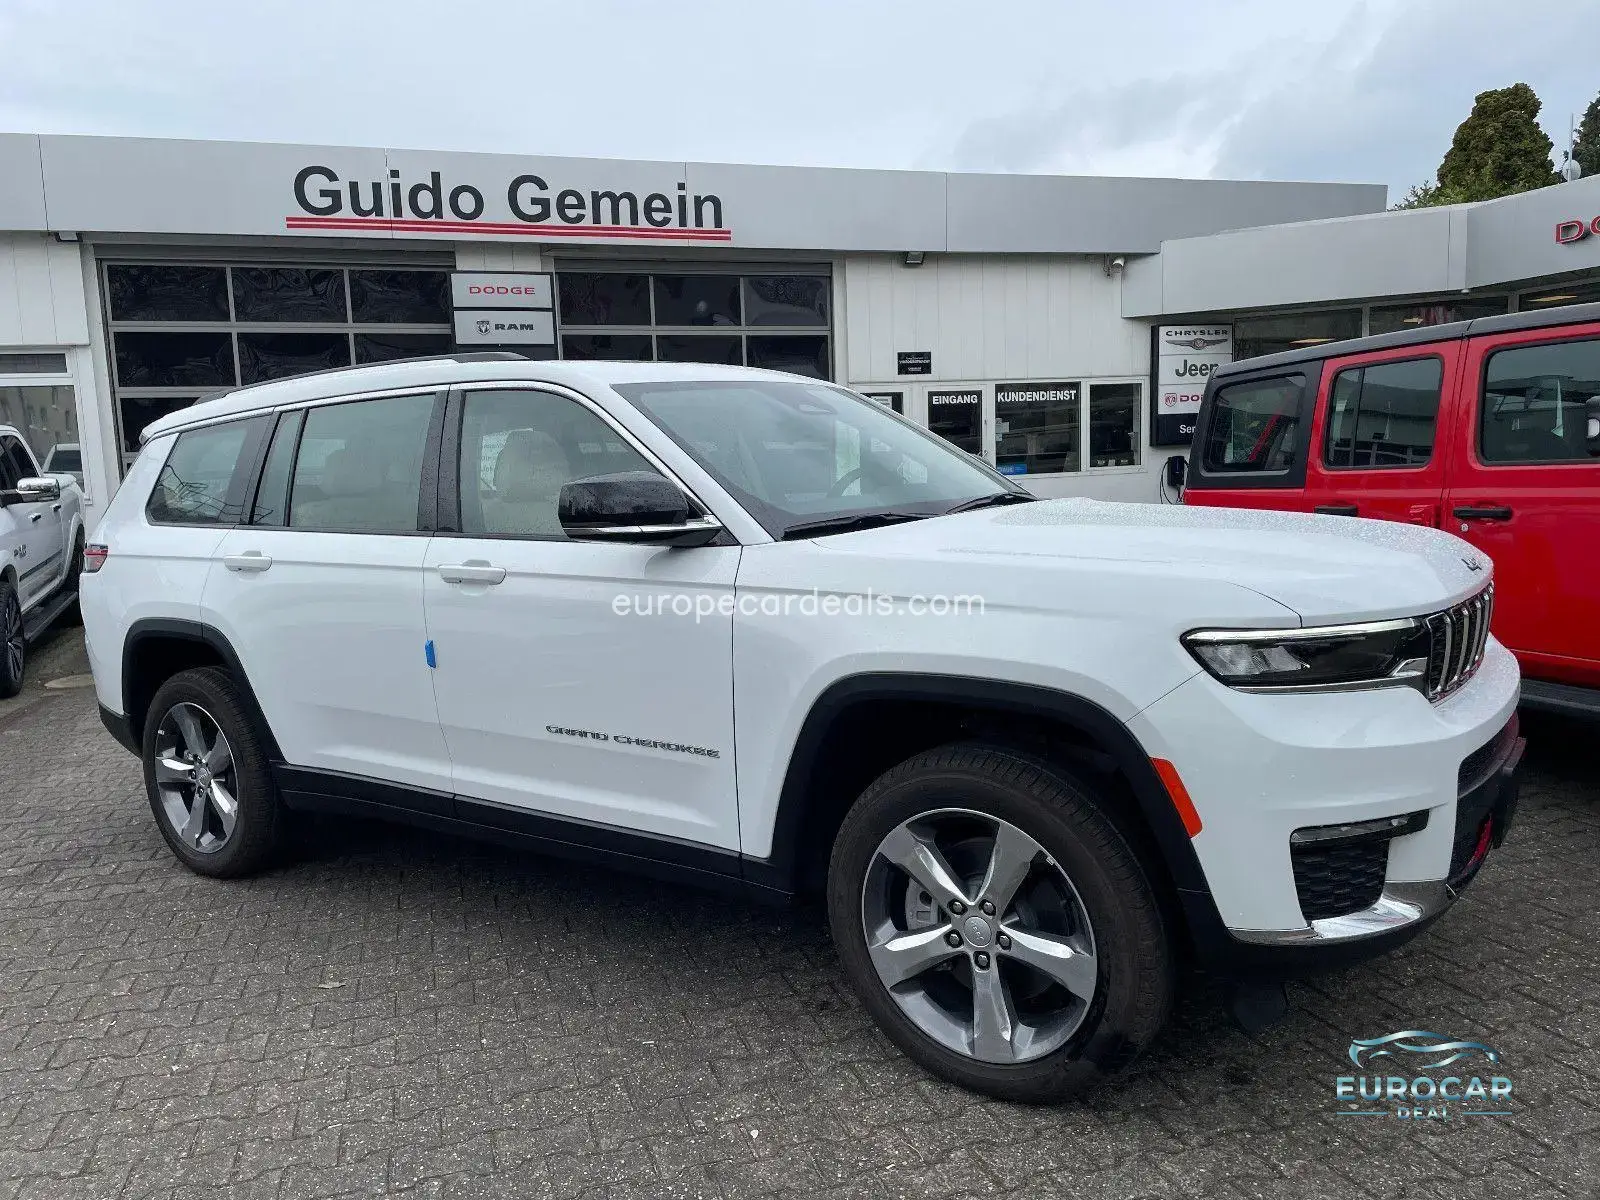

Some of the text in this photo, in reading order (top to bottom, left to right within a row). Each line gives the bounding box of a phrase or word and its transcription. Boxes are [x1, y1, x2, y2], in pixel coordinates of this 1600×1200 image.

[293, 165, 723, 229] Guido Gemein
[469, 286, 536, 295] DODGE
[494, 323, 534, 331] RAM
[1165, 329, 1229, 337] CHRYSLER
[932, 394, 978, 405] EINGANG
[997, 390, 1077, 402] KUNDENDIENST
[545, 724, 721, 759] GRAND CHEROKEE
